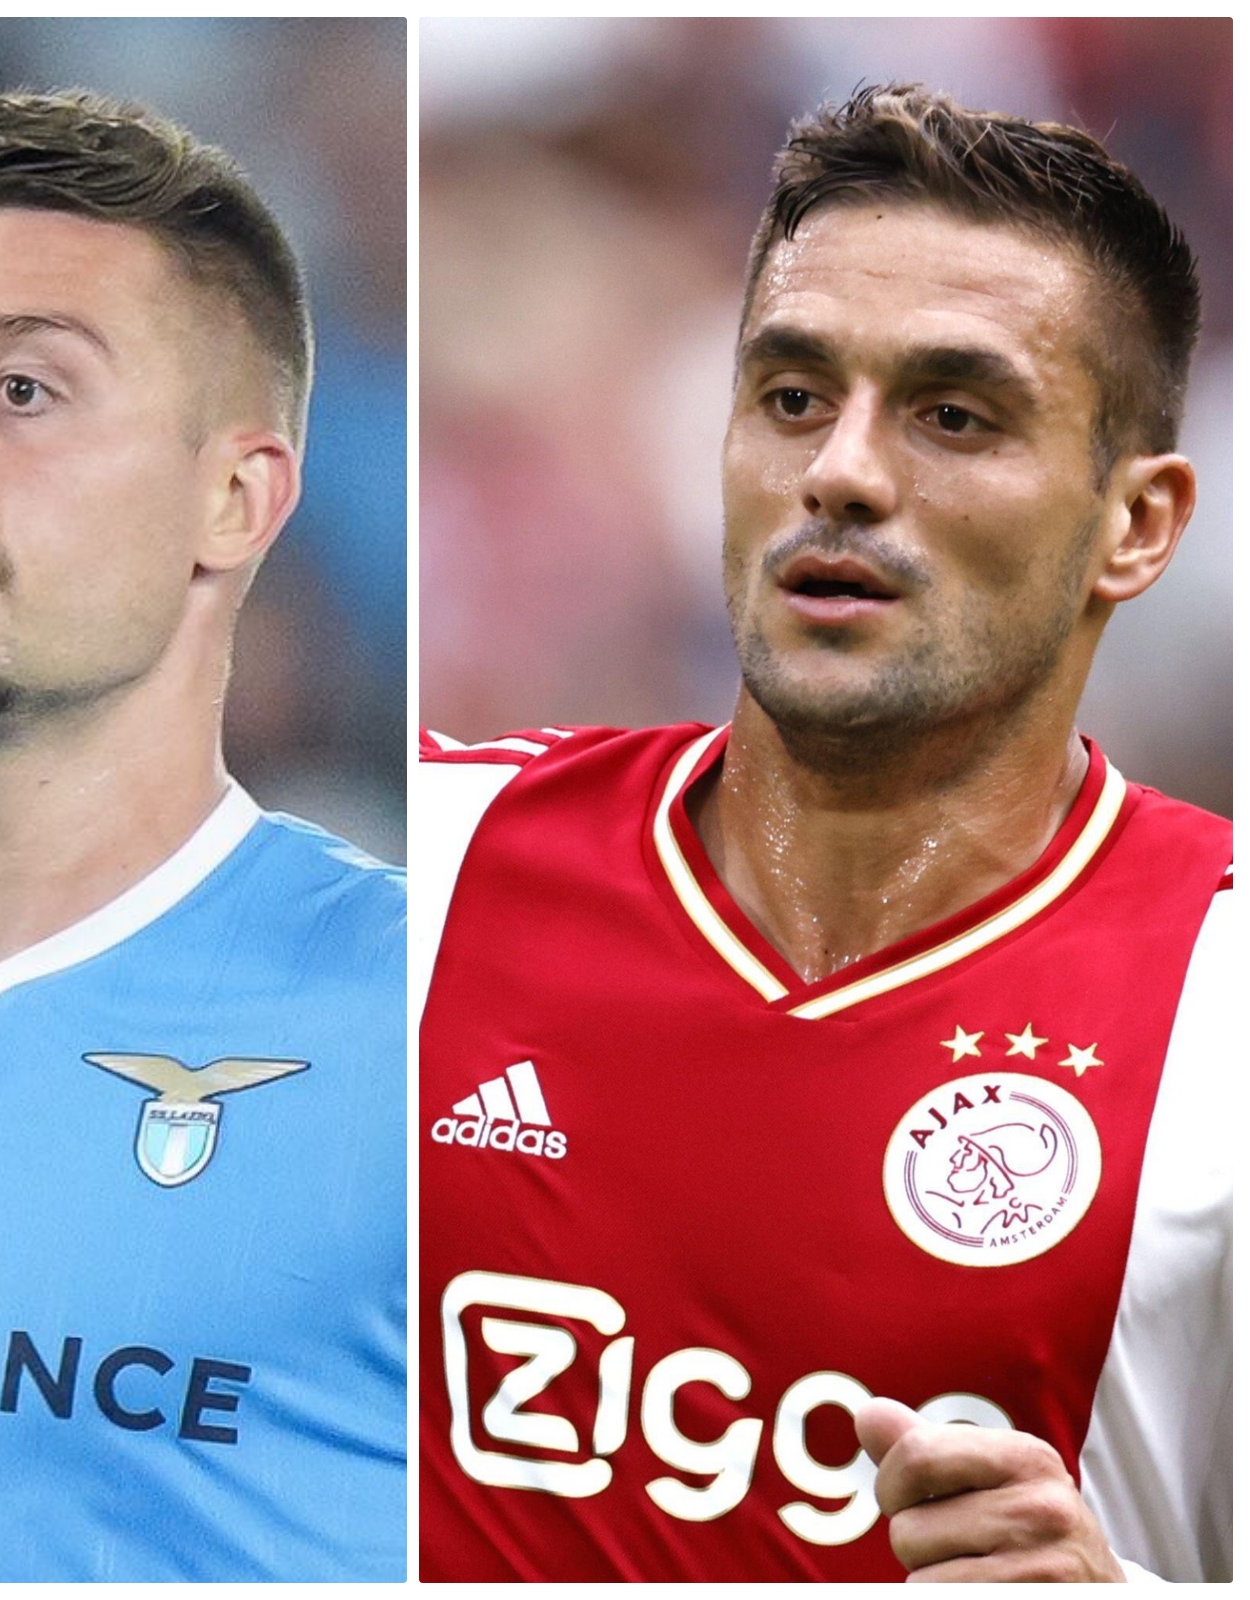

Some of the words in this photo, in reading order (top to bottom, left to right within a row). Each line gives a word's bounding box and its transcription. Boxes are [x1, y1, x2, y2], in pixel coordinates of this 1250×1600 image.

[431, 1115, 567, 1159] adidas
[909, 1085, 1002, 1149] AJAX
[989, 1197, 1067, 1248] AMSTERDAM
[442, 1269, 1015, 1546] Zigg
